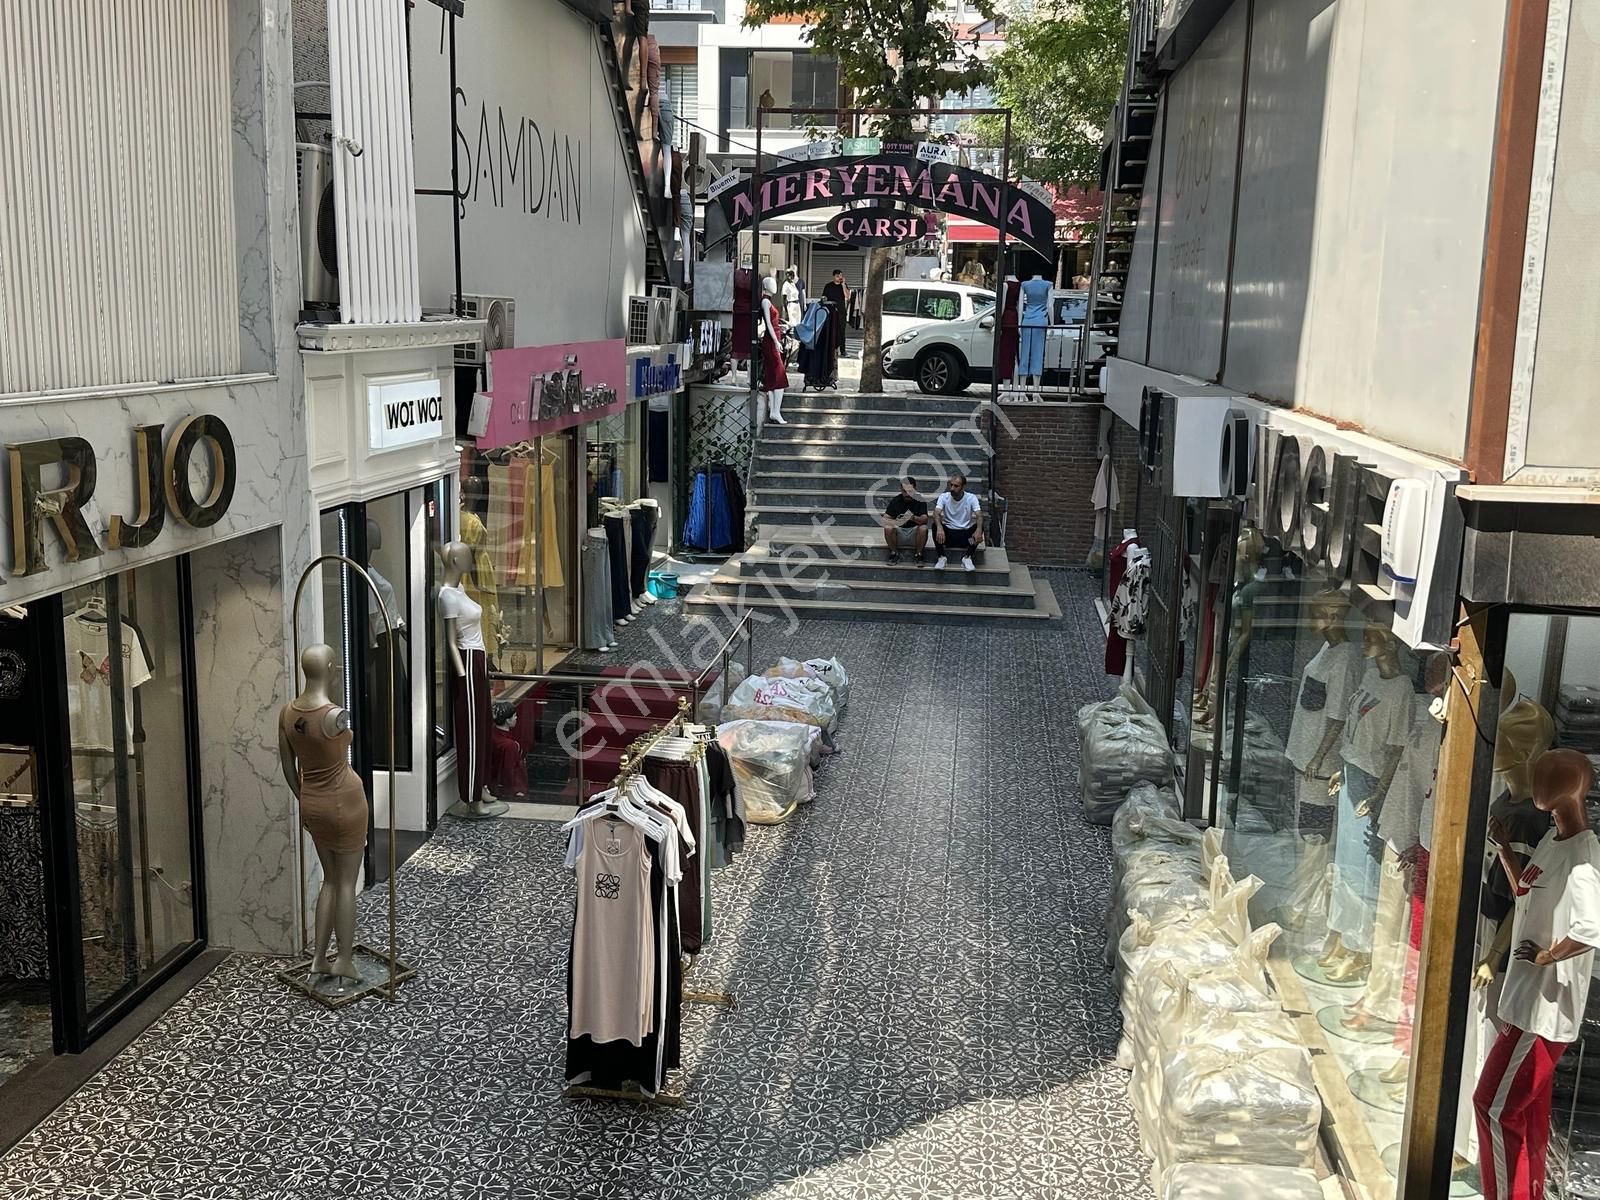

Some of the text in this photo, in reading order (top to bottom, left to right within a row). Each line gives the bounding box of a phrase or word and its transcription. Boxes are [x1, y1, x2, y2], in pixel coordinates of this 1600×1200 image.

[920, 146, 947, 157] AURA
[710, 174, 737, 193] Bluemix
[731, 161, 1036, 240] MERYEMANA
[837, 217, 919, 242] ÇARŞI
[384, 396, 443, 430] WOI WOI
[0, 414, 237, 584] RJO
